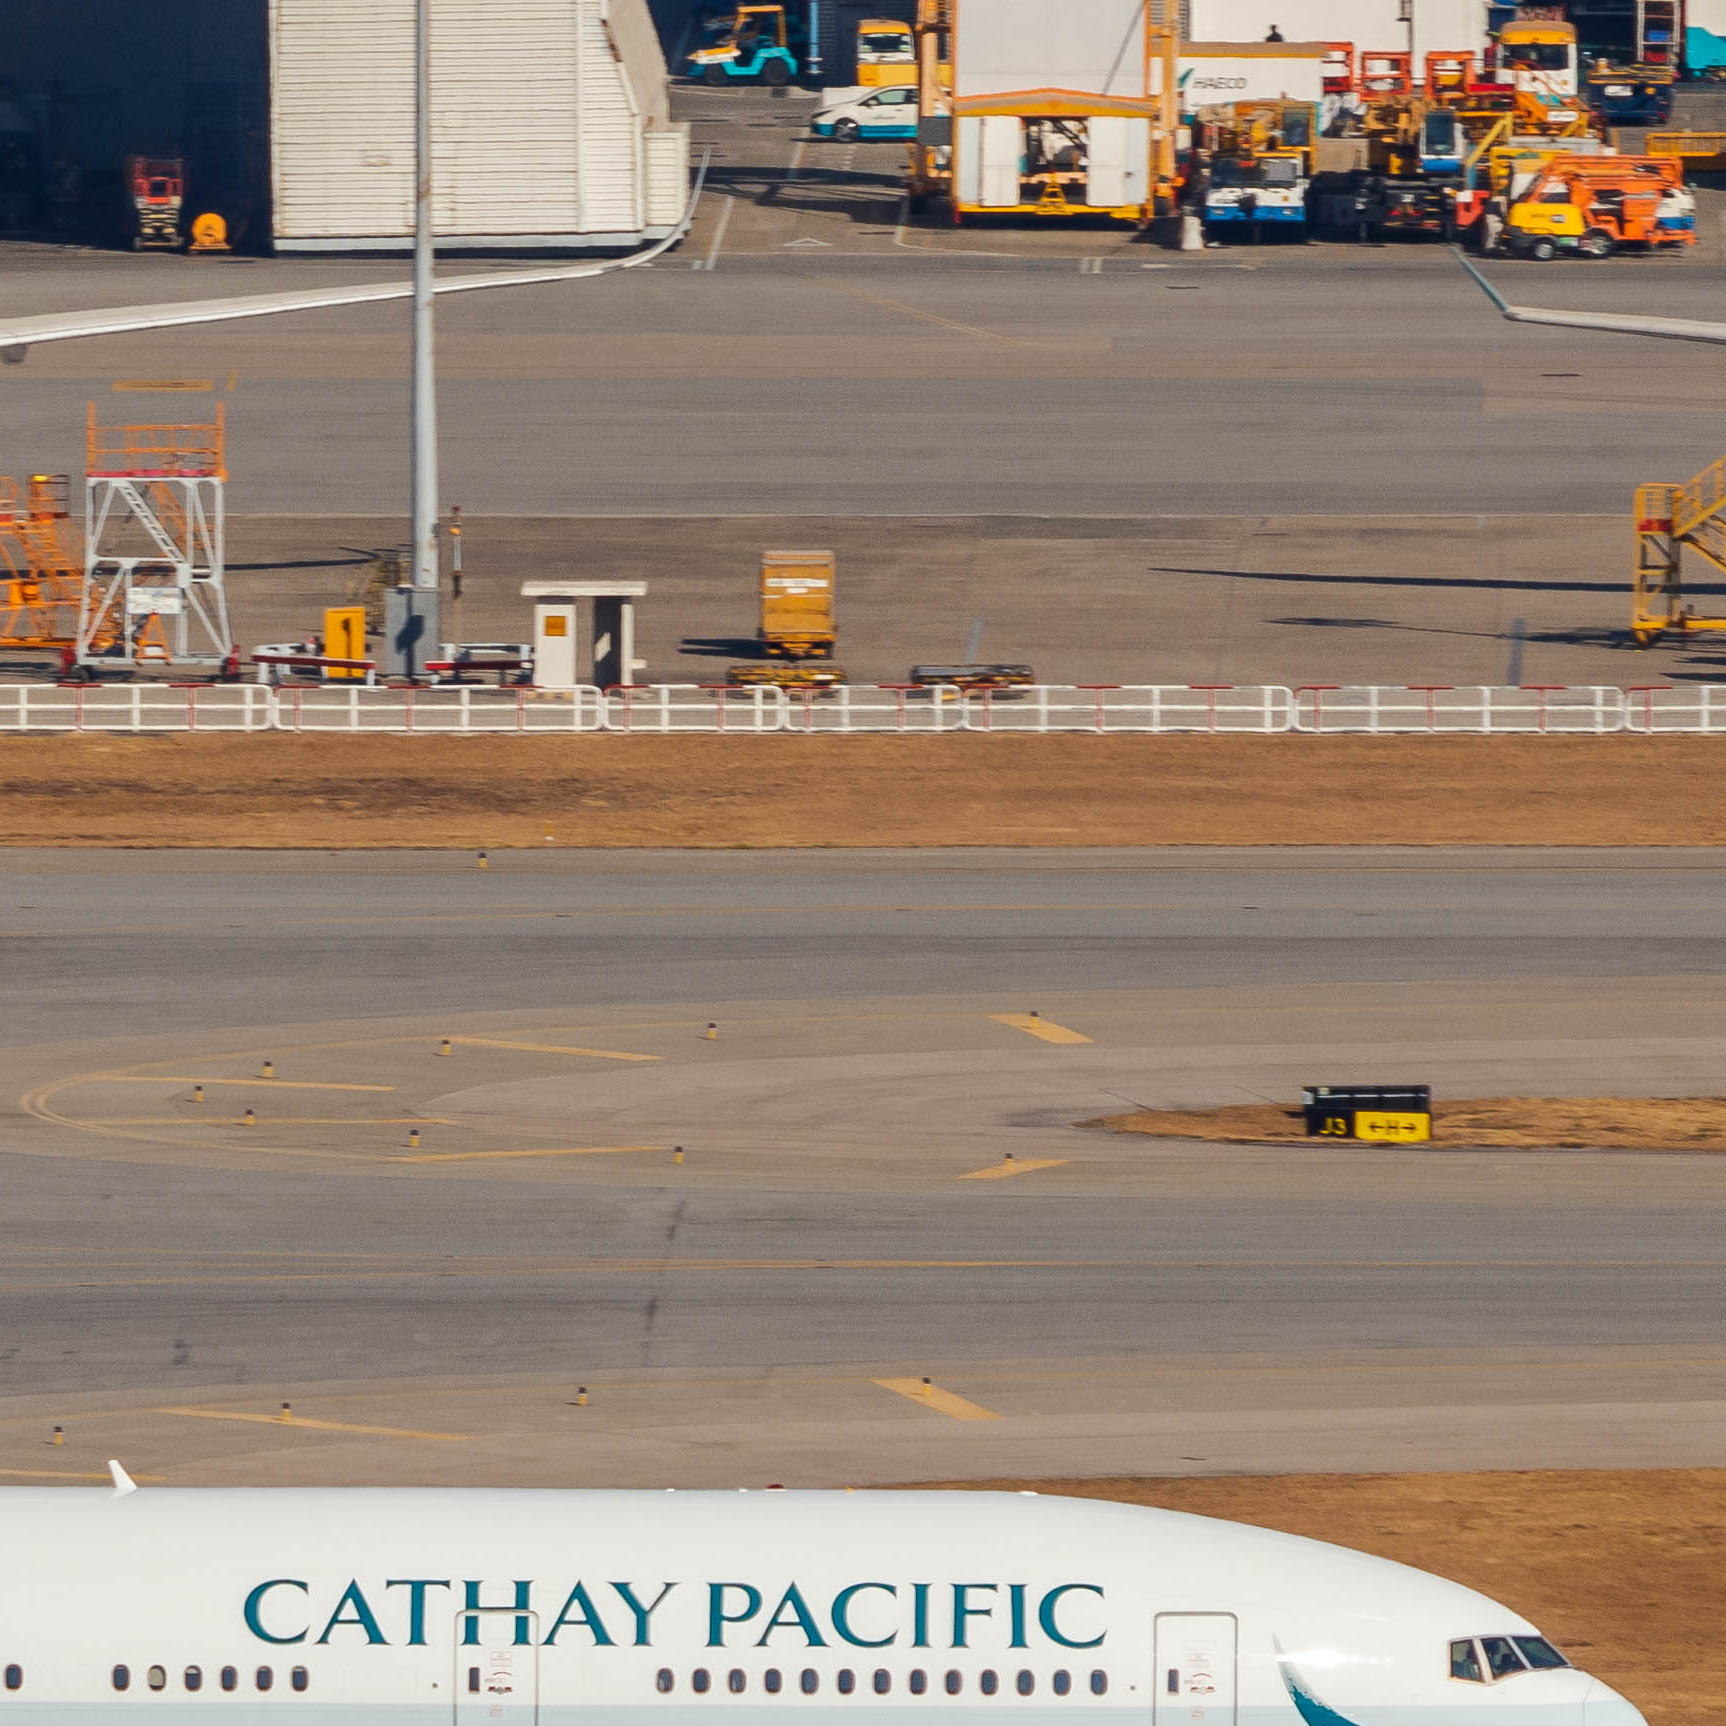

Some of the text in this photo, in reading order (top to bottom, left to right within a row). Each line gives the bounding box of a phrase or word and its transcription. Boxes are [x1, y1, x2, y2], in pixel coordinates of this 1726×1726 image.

[1319, 1118, 1346, 1135] J3
[243, 1578, 1109, 1649] CATHAY PACIFIC
